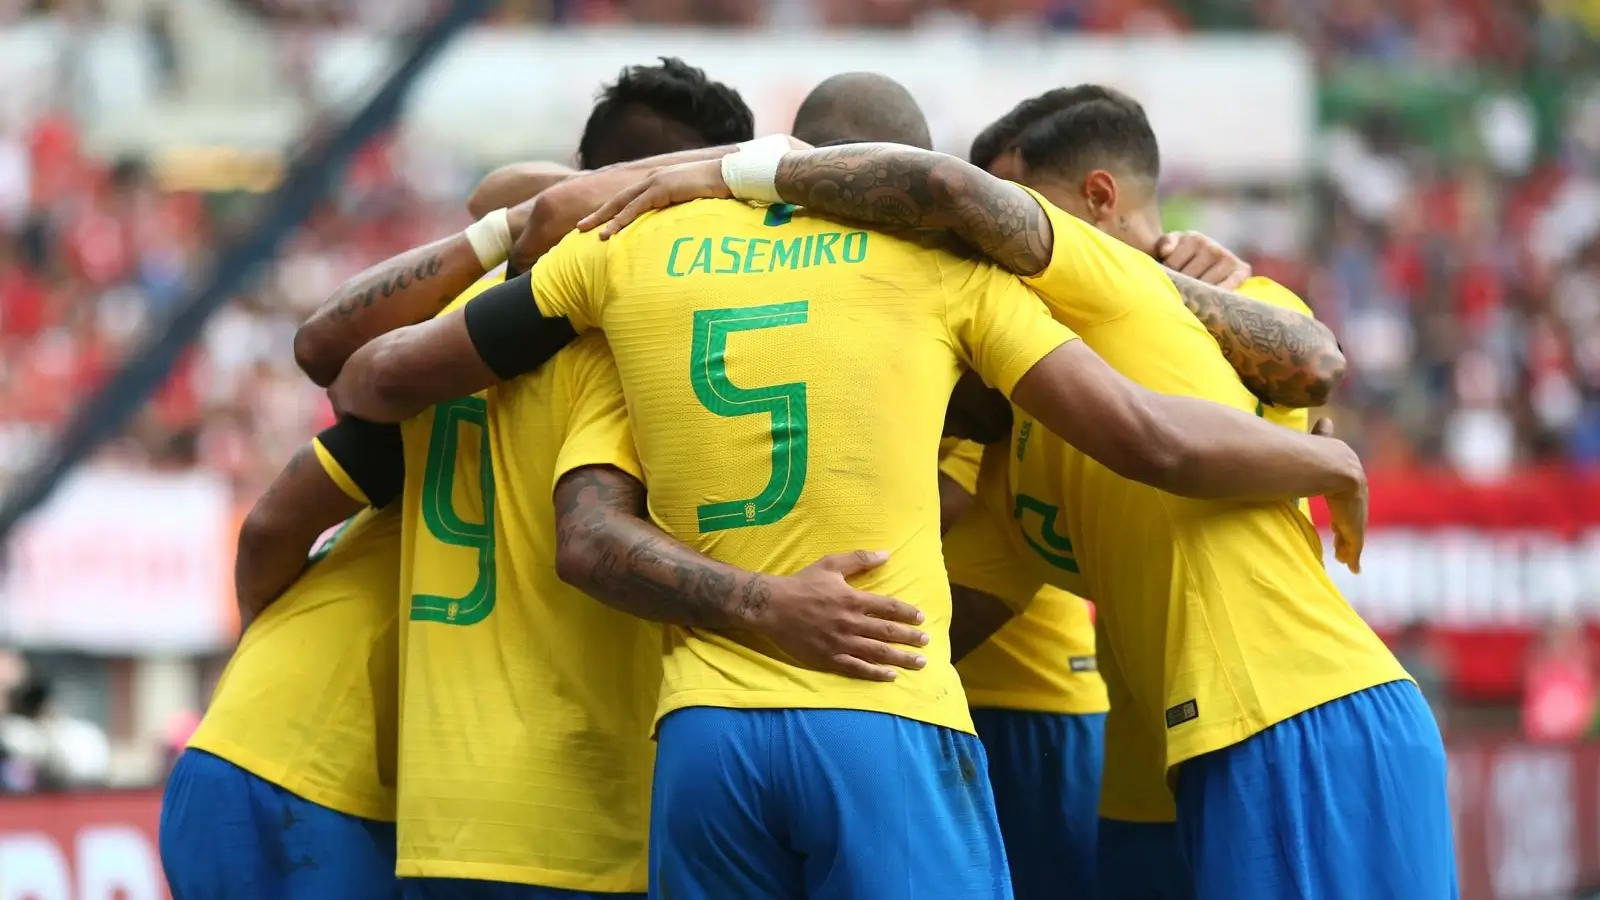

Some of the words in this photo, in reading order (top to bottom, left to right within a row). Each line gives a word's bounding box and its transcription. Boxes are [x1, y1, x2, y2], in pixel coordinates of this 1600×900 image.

[666, 231, 868, 277] CASEMIRO
[410, 396, 497, 626] 9
[690, 300, 808, 533] 5
